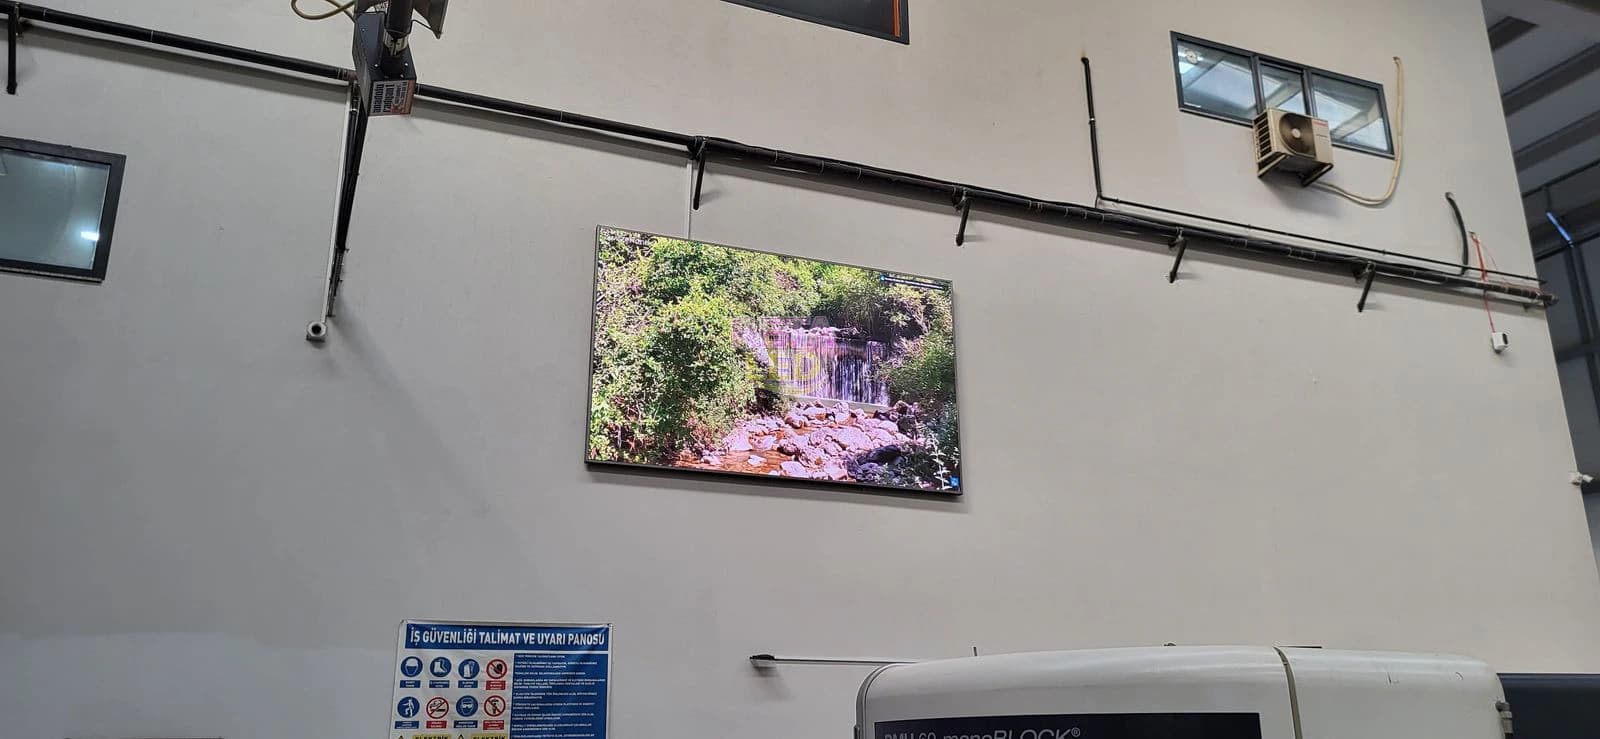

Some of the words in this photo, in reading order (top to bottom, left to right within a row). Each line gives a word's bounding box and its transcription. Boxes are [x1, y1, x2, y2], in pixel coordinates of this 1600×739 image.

[410, 627, 420, 646] İŞ
[422, 627, 477, 644] GÜVENLİĞİ
[479, 629, 521, 645] TALİMAT
[523, 632, 535, 645] VE
[537, 632, 566, 645] UYARI
[568, 632, 605, 646] PANOSU
